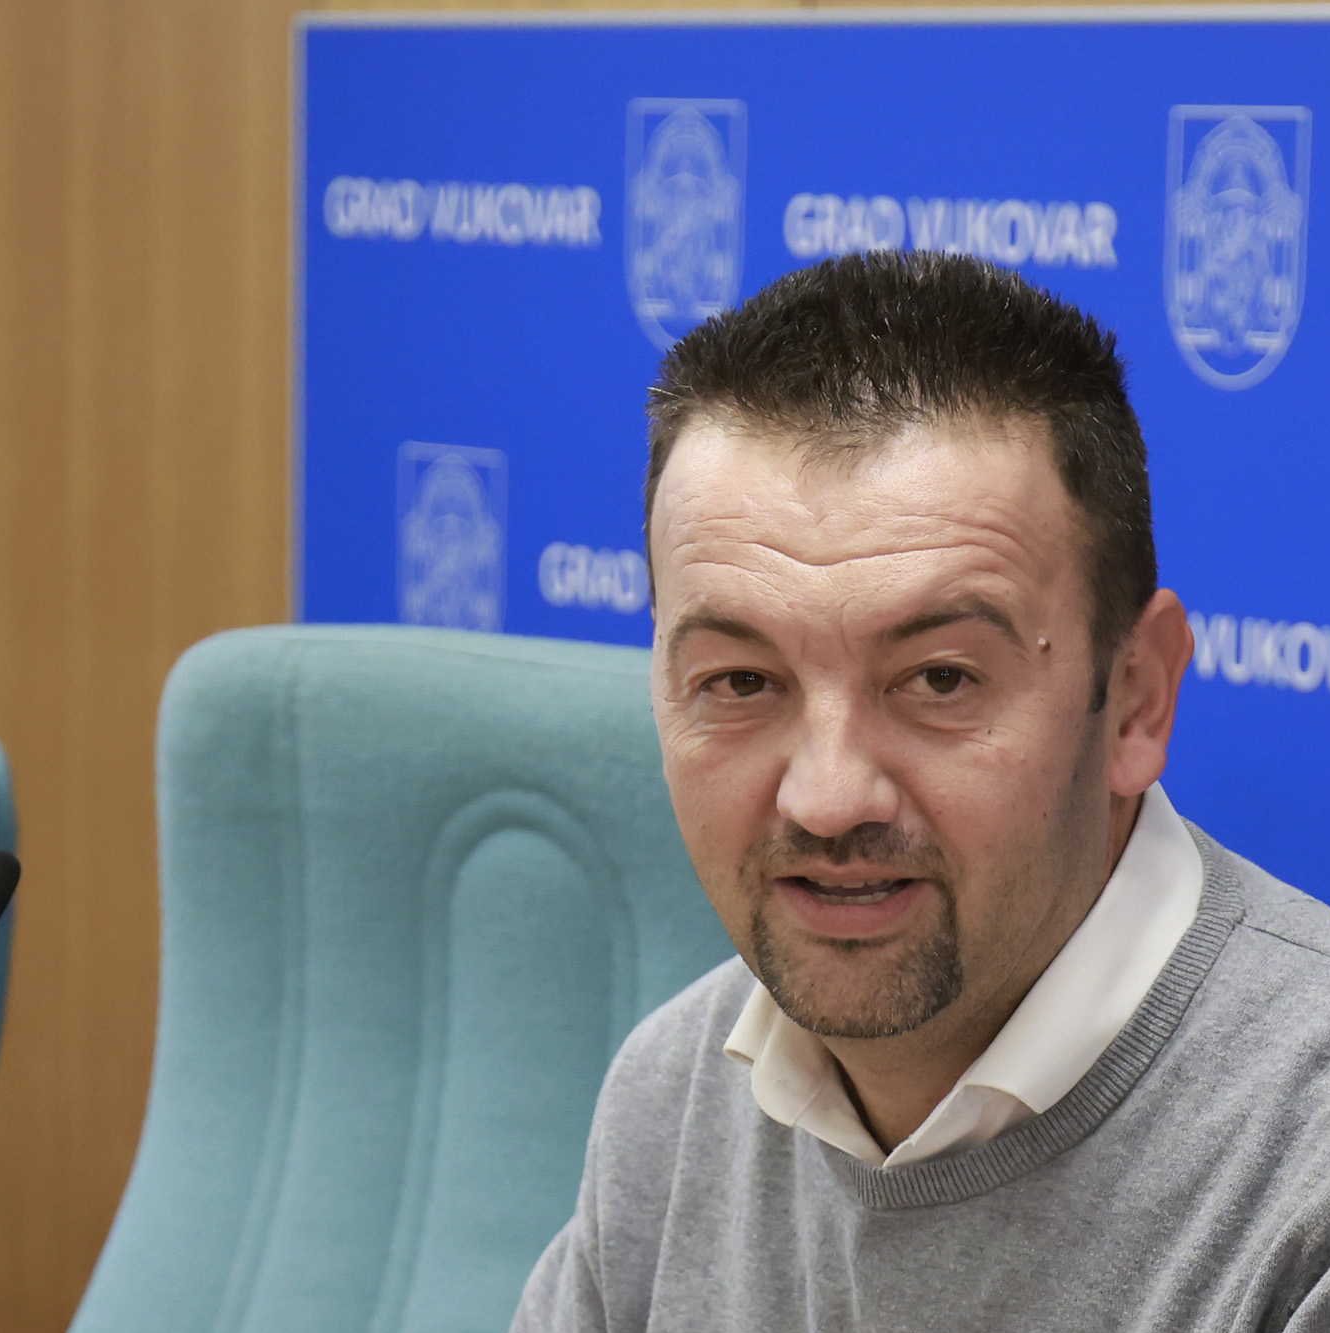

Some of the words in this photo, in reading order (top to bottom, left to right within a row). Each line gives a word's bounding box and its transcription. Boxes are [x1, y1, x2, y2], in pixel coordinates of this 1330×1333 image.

[323, 175, 428, 242] GRAD
[428, 179, 602, 246] VUKOVAR
[782, 192, 905, 258] GRAD
[906, 196, 1117, 270] VUKOVAR
[537, 541, 650, 614] GRAD
